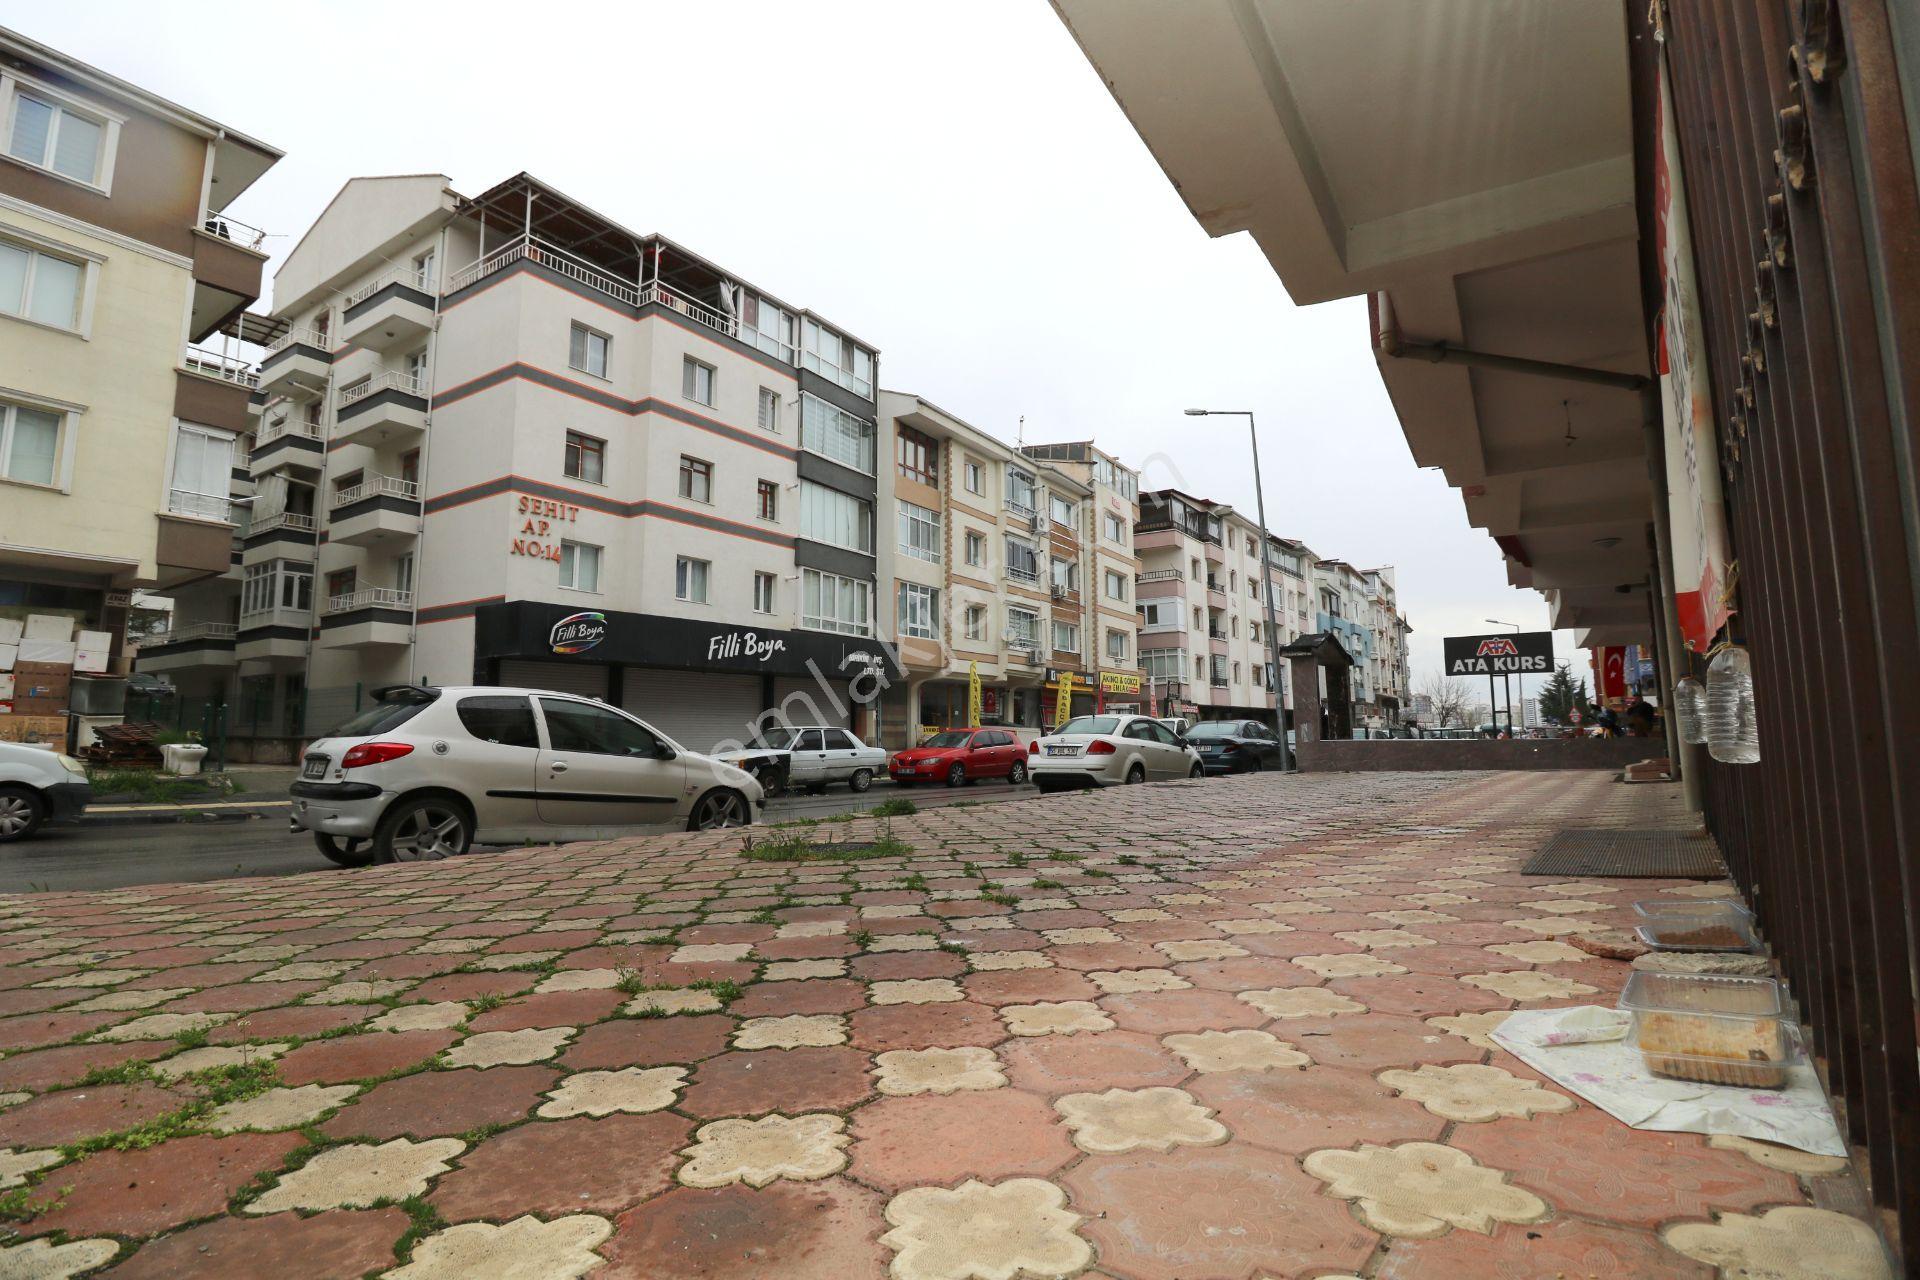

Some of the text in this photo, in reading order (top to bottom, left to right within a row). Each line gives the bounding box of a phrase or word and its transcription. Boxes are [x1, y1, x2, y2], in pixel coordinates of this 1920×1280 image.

[521, 518, 551, 536] AP.
[510, 538, 561, 564] NO:14
[557, 624, 604, 641] Filli Boya
[708, 632, 786, 662] Filli Boya
[1453, 655, 1546, 673] ATA KURS
